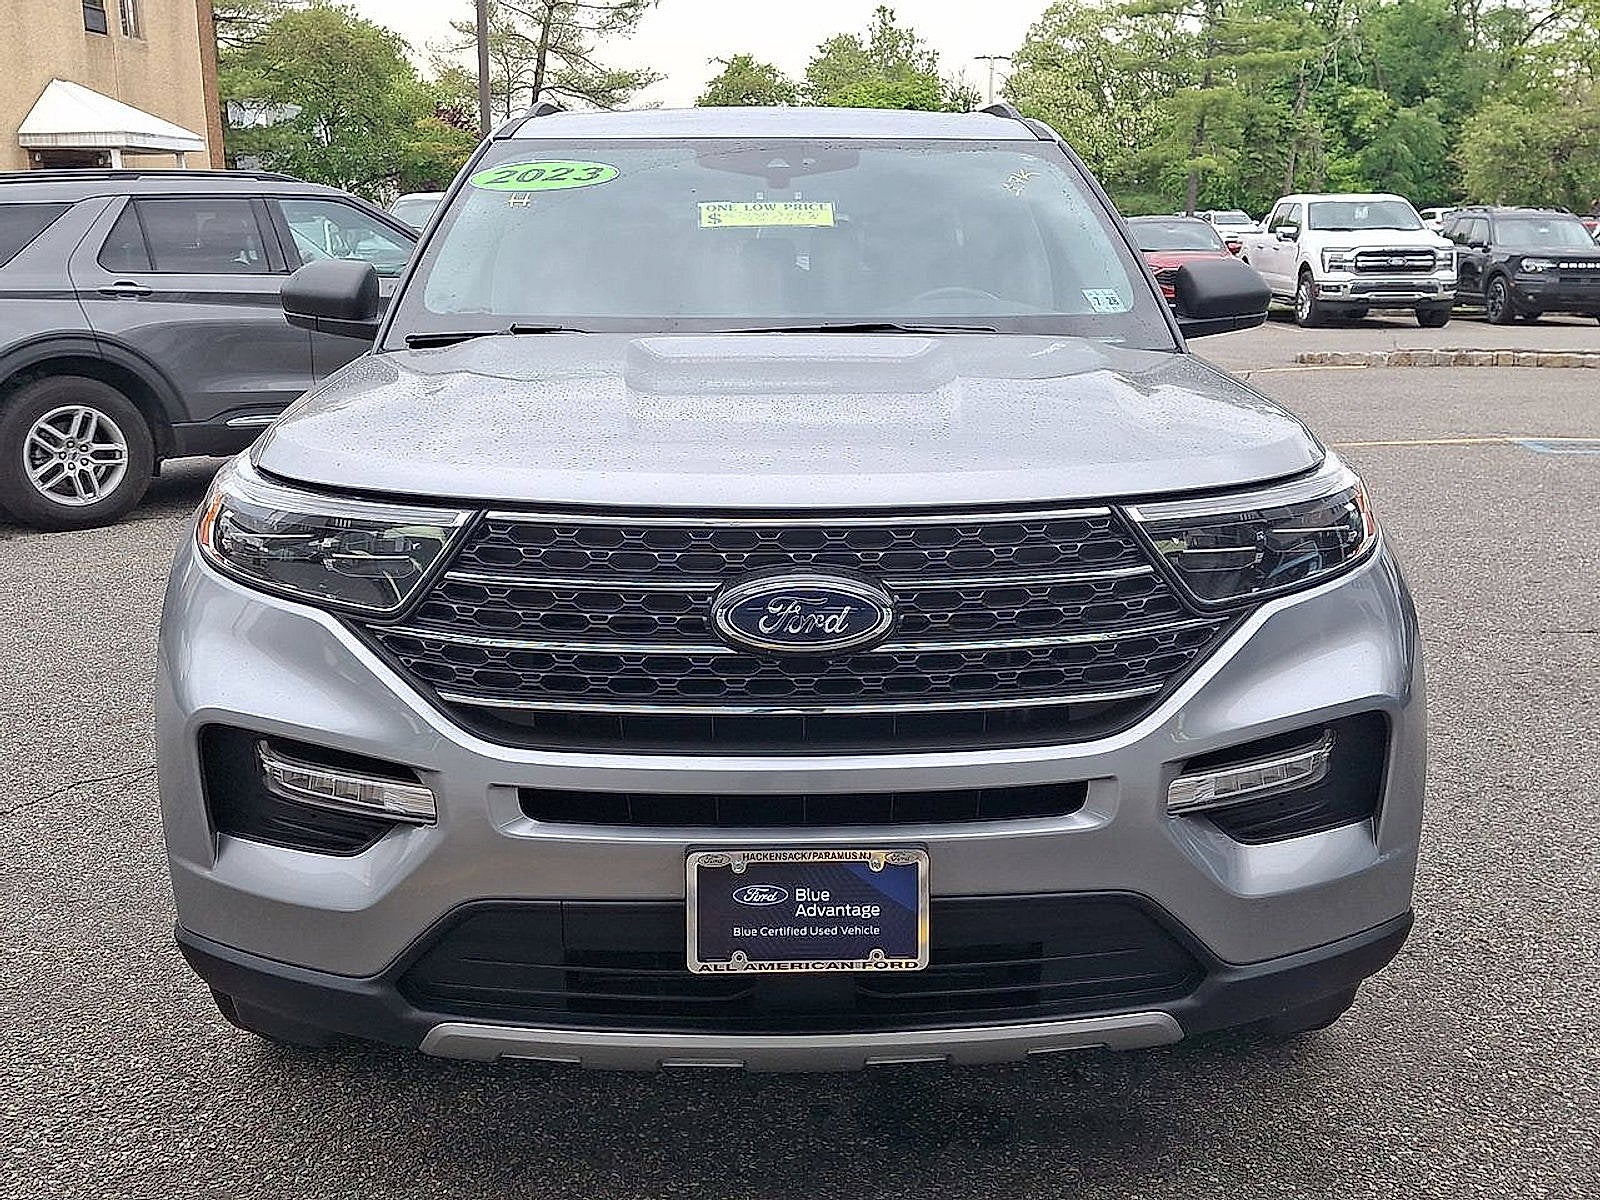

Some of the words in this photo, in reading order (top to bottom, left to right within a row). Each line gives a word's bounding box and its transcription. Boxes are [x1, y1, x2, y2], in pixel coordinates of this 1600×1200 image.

[484, 167, 604, 184] 2023
[706, 204, 737, 212] ONE
[783, 203, 827, 211] PRICE
[758, 596, 851, 634] Ford
[743, 887, 778, 902] Ford
[795, 887, 830, 902] Blue
[795, 903, 881, 918] Advantage
[733, 927, 758, 937] Blue
[760, 926, 808, 937] Certified
[809, 926, 838, 936] Used
[841, 925, 880, 936] Vehicle
[699, 963, 738, 972] ALL
[743, 961, 854, 971] AMERICAN
[862, 961, 919, 970] FORD
